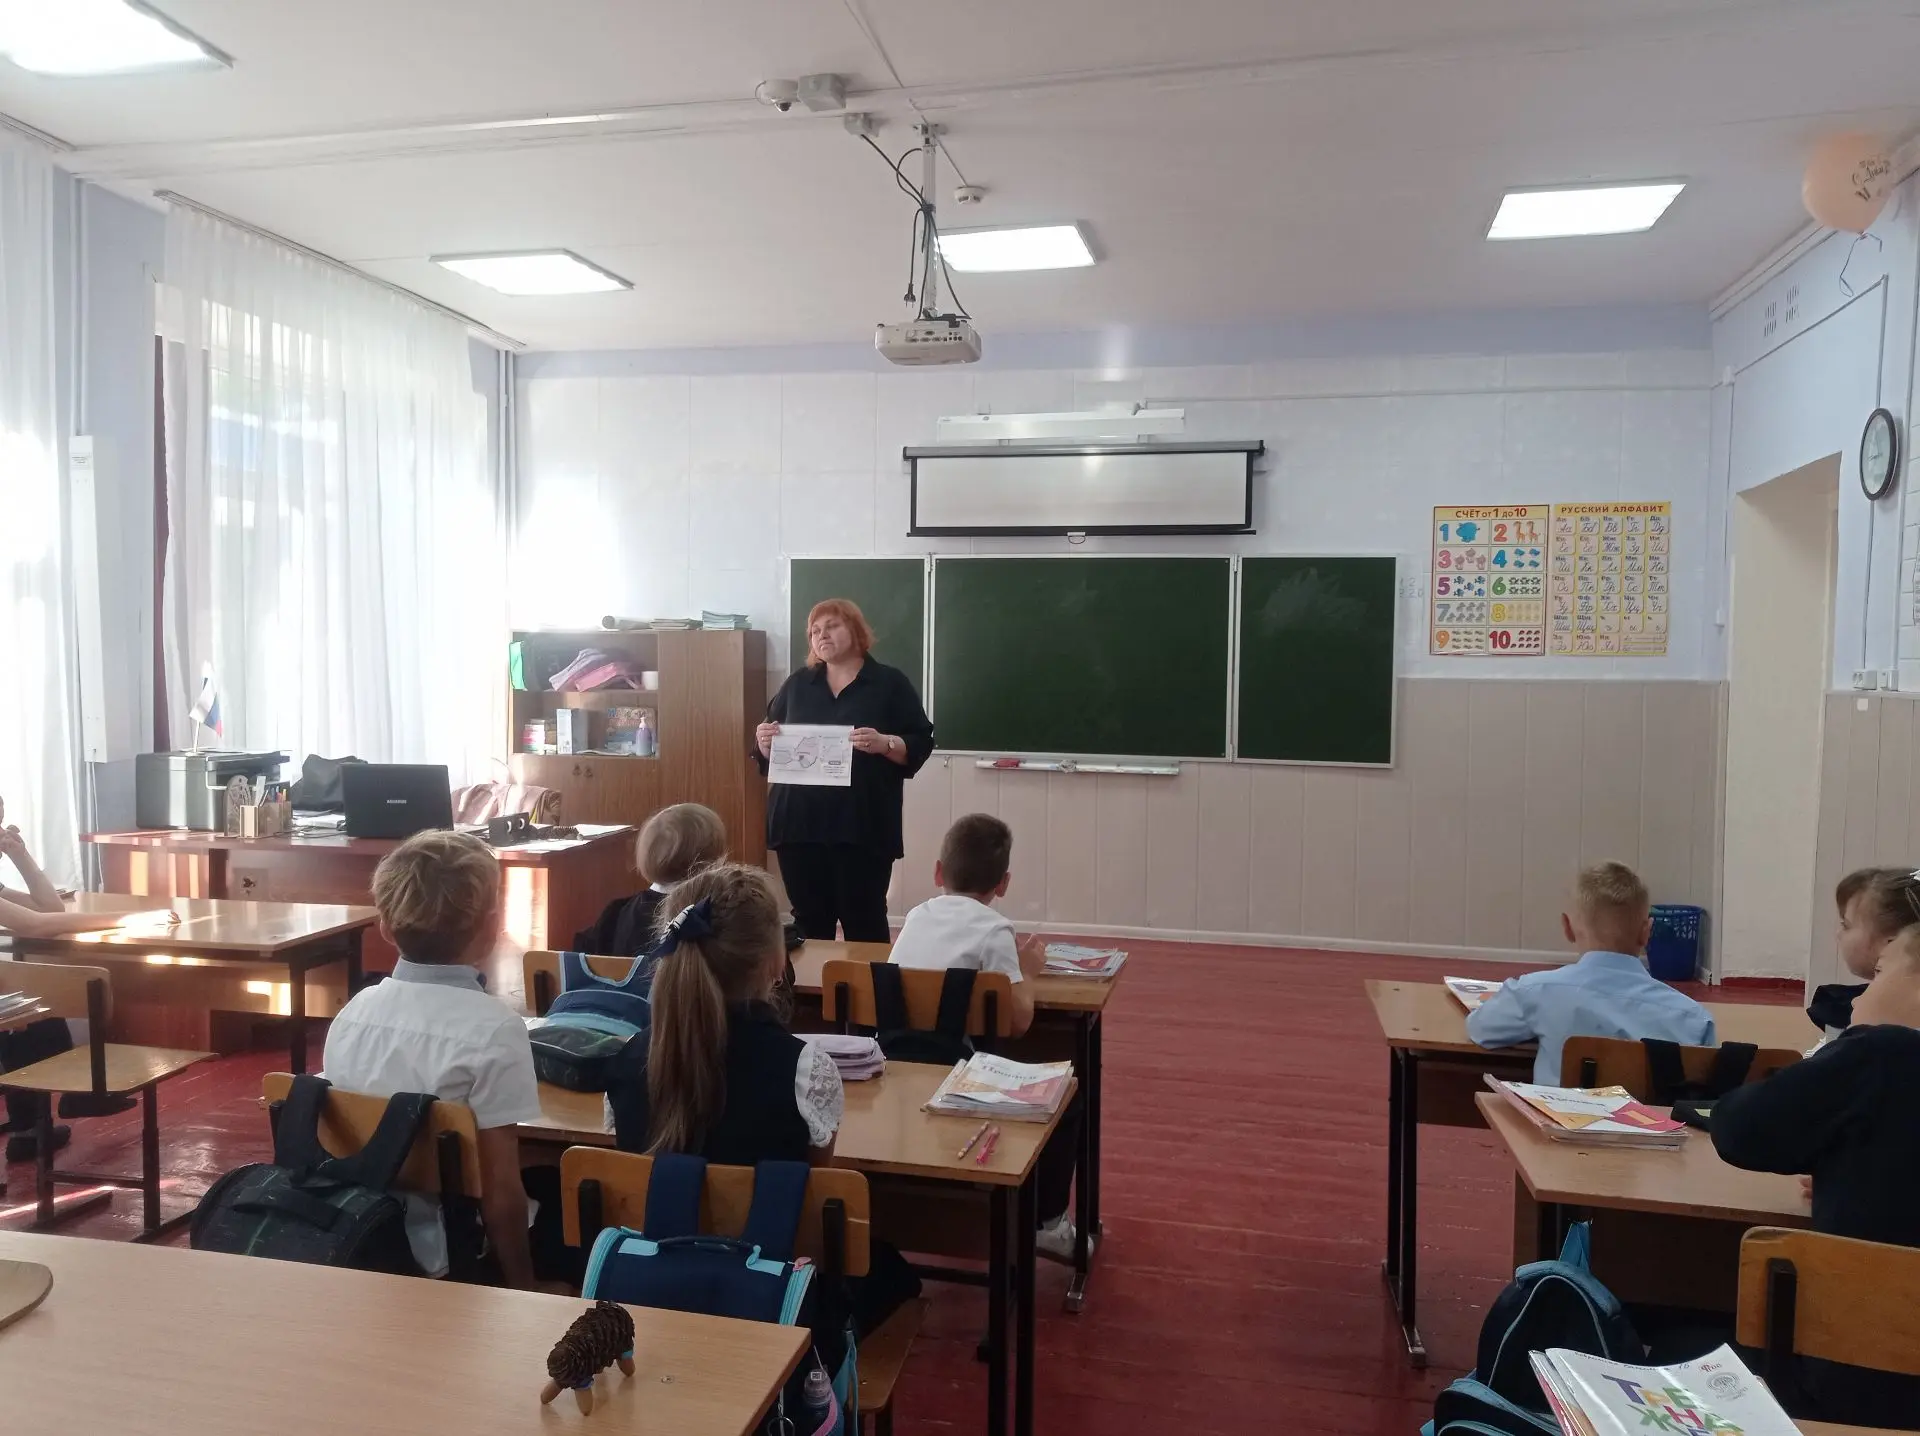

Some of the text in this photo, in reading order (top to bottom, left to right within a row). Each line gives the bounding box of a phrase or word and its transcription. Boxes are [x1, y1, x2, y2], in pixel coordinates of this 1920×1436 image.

[1455, 508, 1480, 518] СЧЁТ
[1493, 508, 1499, 518] 1
[1514, 507, 1527, 517] 10
[1561, 505, 1664, 513] РУССКИЙ АЛФАВИТ
[1440, 524, 1449, 542] 1
[1494, 524, 1507, 542] 2
[1438, 550, 1452, 568] 3
[1492, 550, 1507, 568] 4
[1437, 577, 1450, 595] 5
[1492, 577, 1506, 595] 6
[1437, 604, 1450, 622] 7
[1491, 604, 1505, 622] 8
[1436, 631, 1449, 649] 9
[1489, 631, 1511, 649] 10
